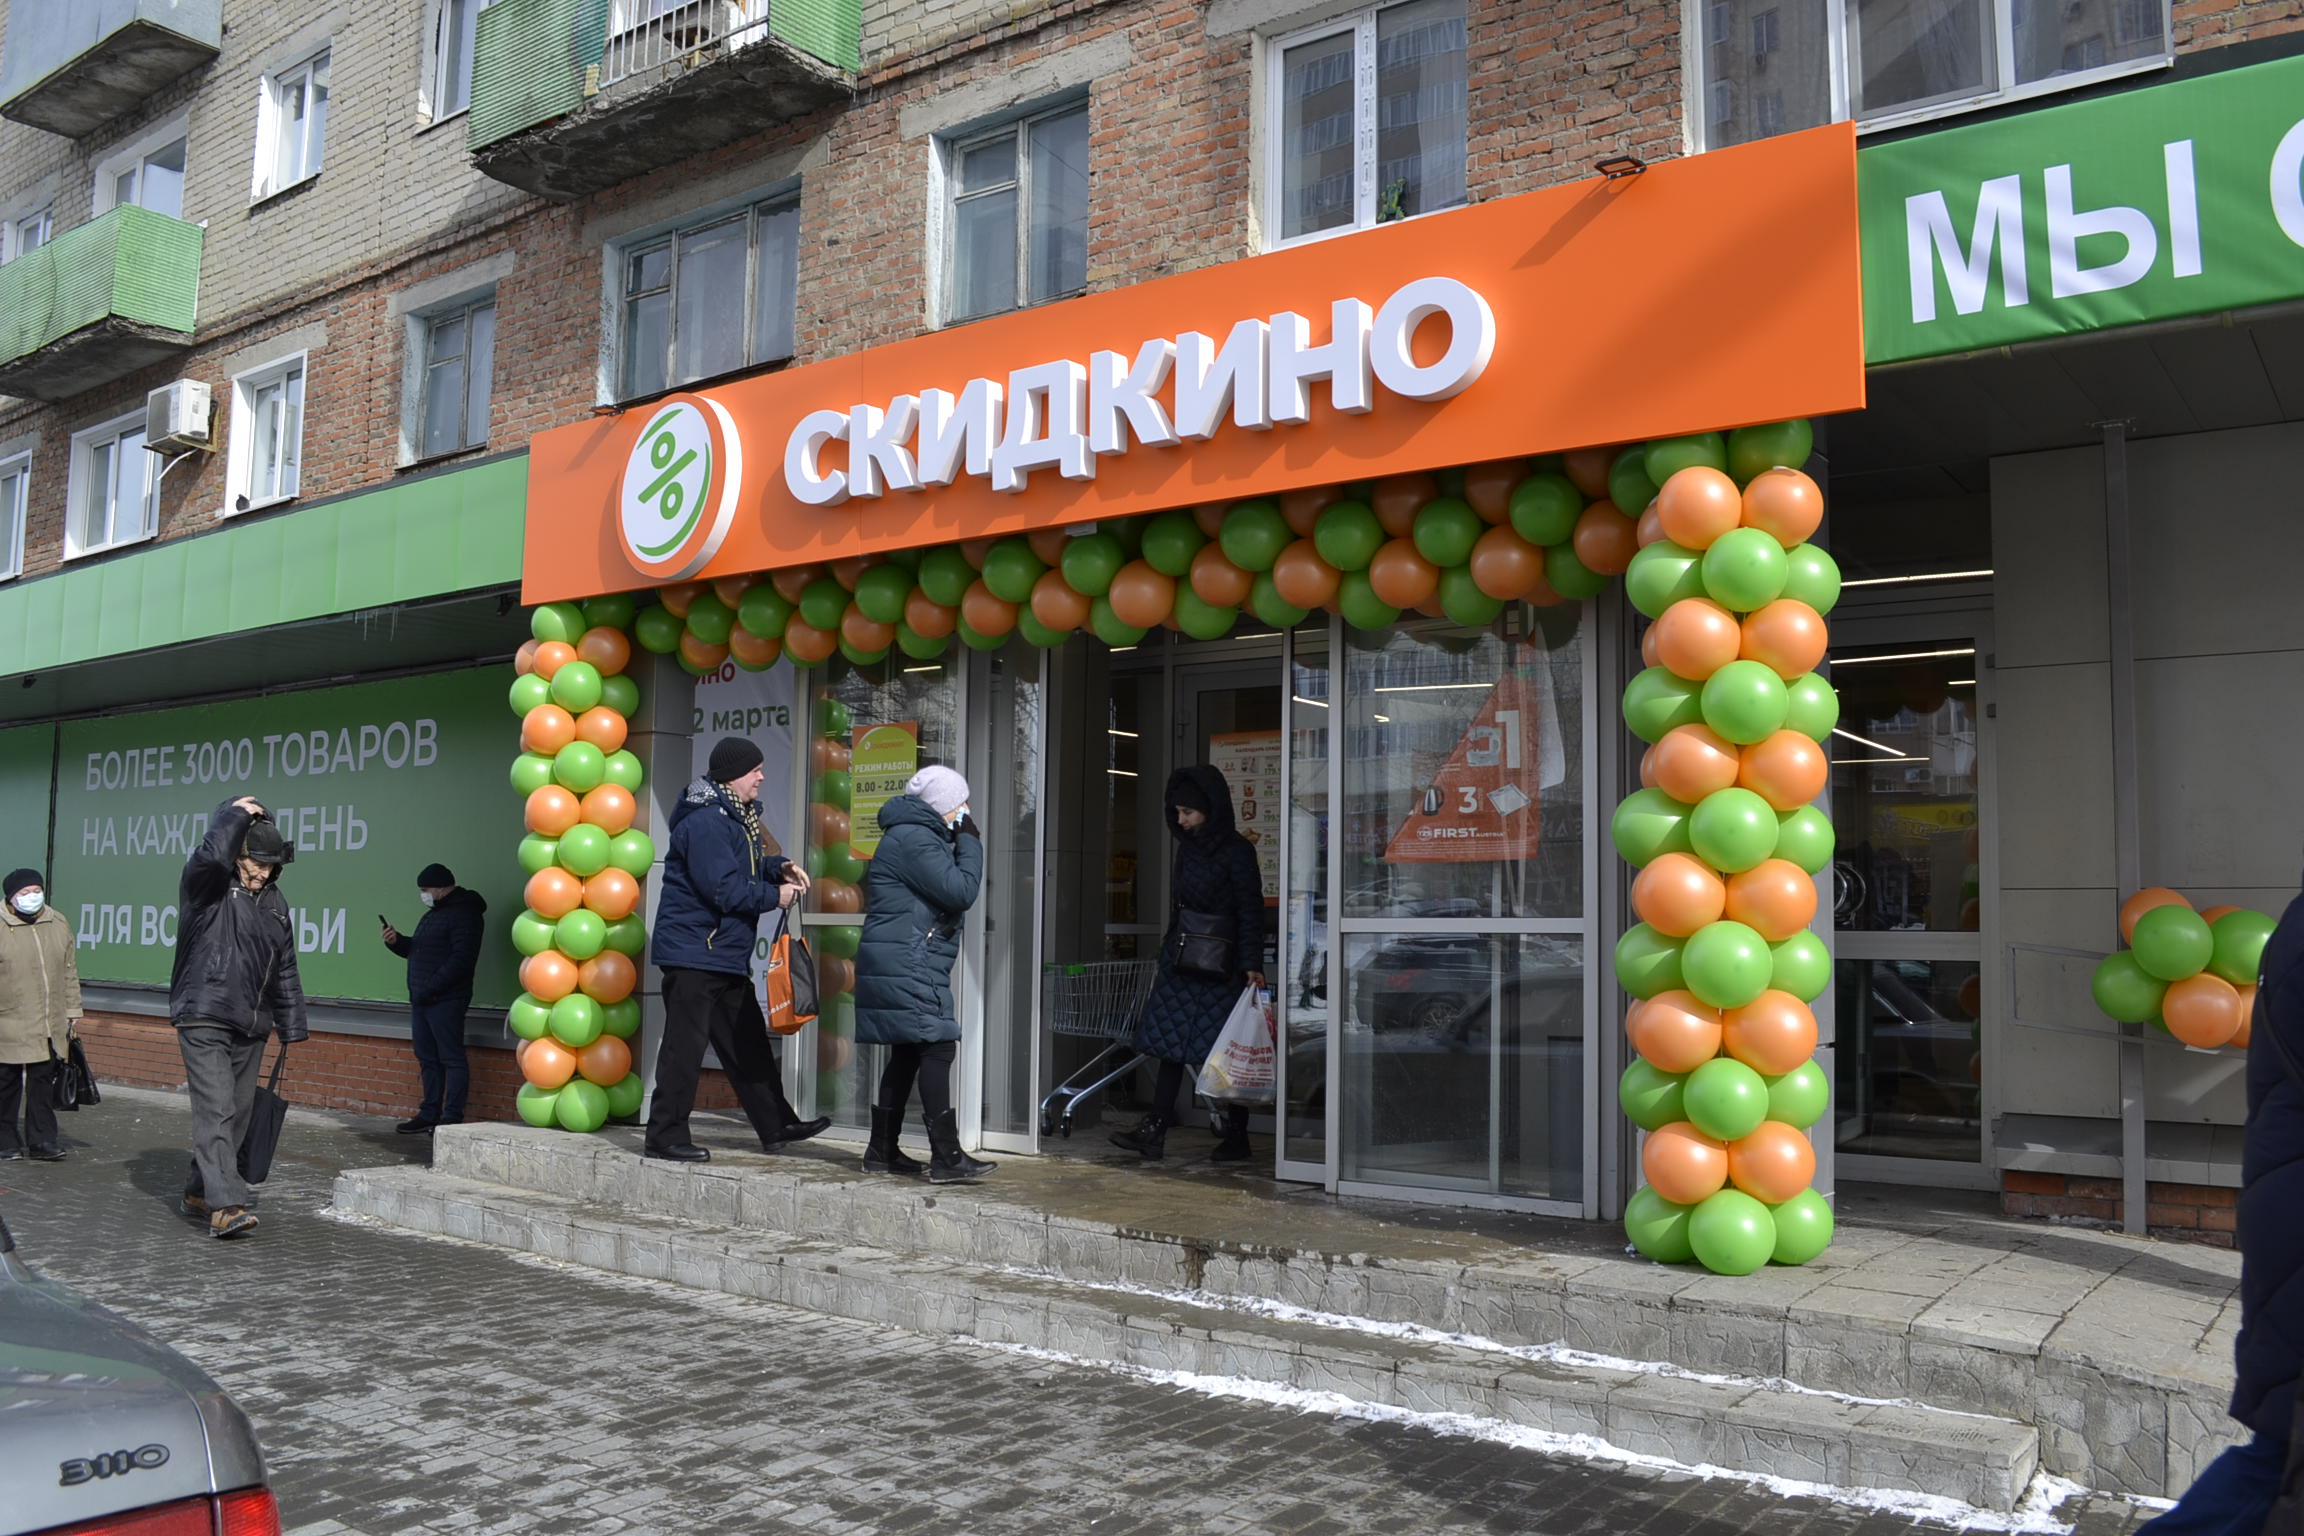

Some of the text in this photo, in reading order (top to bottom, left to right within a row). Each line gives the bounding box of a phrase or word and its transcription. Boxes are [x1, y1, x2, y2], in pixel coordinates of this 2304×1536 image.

[1905, 139, 2203, 324] МЫ
[783, 276, 1496, 506] СКИДКИНО
[712, 704, 790, 736] марта
[85, 719, 438, 792] БОЛЕЕ 3000 ТОВАРОВ
[854, 760, 914, 773] РЕЖИМ РАБОТЫ
[856, 782, 876, 793] 8.00
[1457, 786, 1478, 813] 3
[82, 817, 118, 856] НА
[126, 813, 208, 861] КАЖД
[1434, 827, 1478, 838] FIRST
[76, 903, 132, 950] ДЛЯ
[140, 905, 178, 947] ВС
[59, 1443, 170, 1487] 3110
